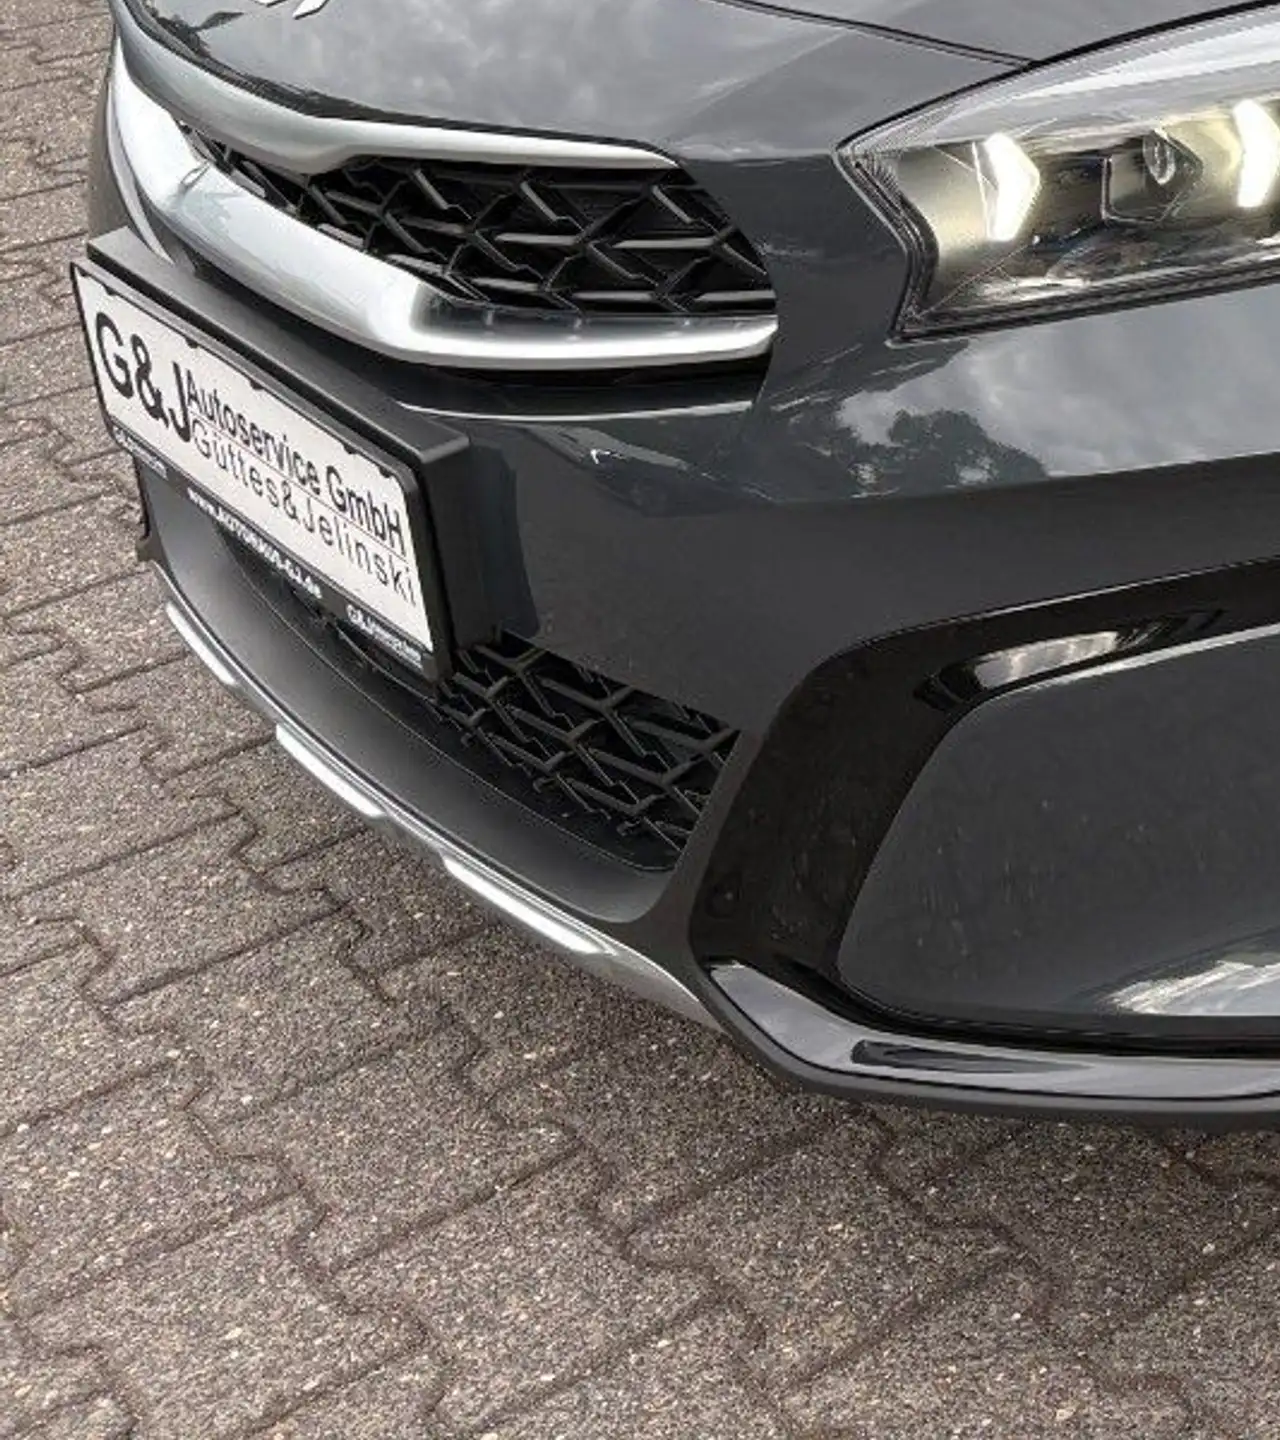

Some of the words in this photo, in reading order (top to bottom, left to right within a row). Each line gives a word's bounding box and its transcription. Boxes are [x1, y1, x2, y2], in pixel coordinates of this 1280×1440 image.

[96, 313, 191, 443] G&J
[187, 369, 320, 495] Autoservice
[327, 465, 407, 557] GmbH
